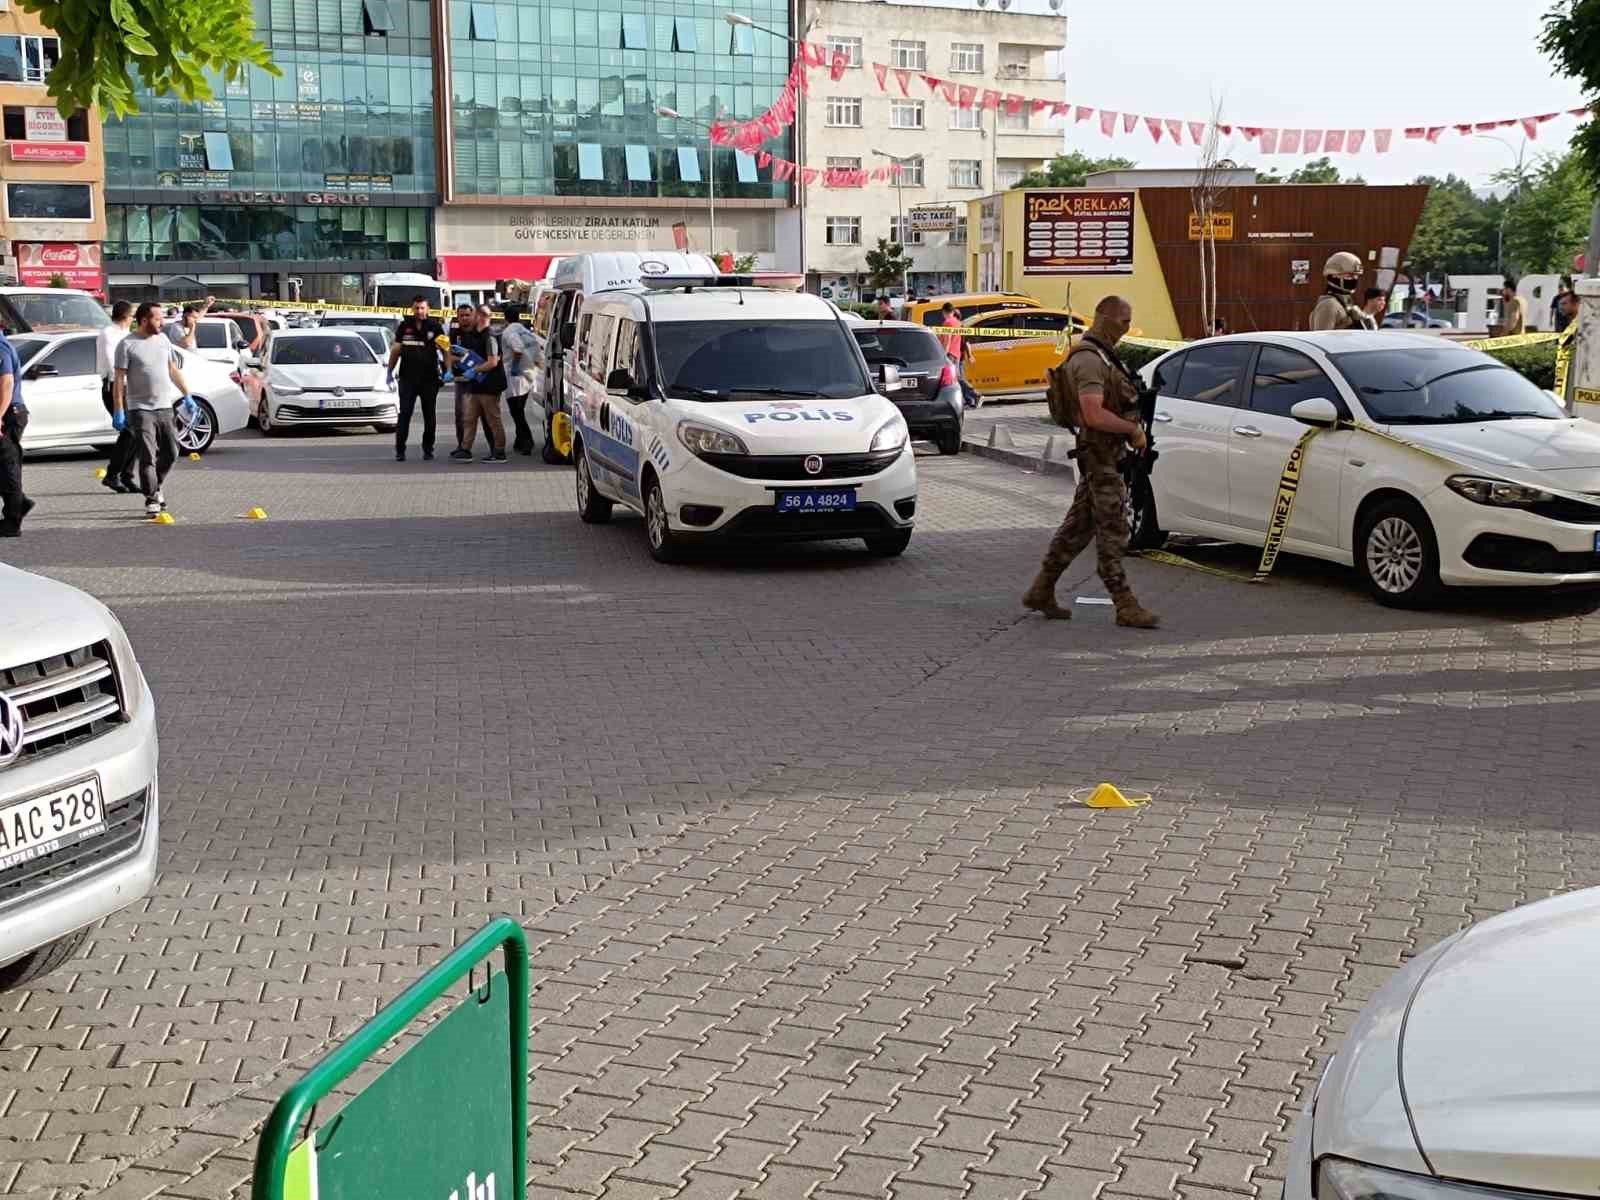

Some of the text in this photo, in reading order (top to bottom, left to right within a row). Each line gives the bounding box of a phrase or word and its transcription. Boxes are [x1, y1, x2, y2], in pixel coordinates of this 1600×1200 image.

[1074, 197, 1131, 211] REKLAM
[584, 216, 620, 227] ZİRAAT
[622, 217, 660, 228] KATILIM
[785, 494, 848, 507] 56 A 4824
[48, 787, 96, 832] 528
